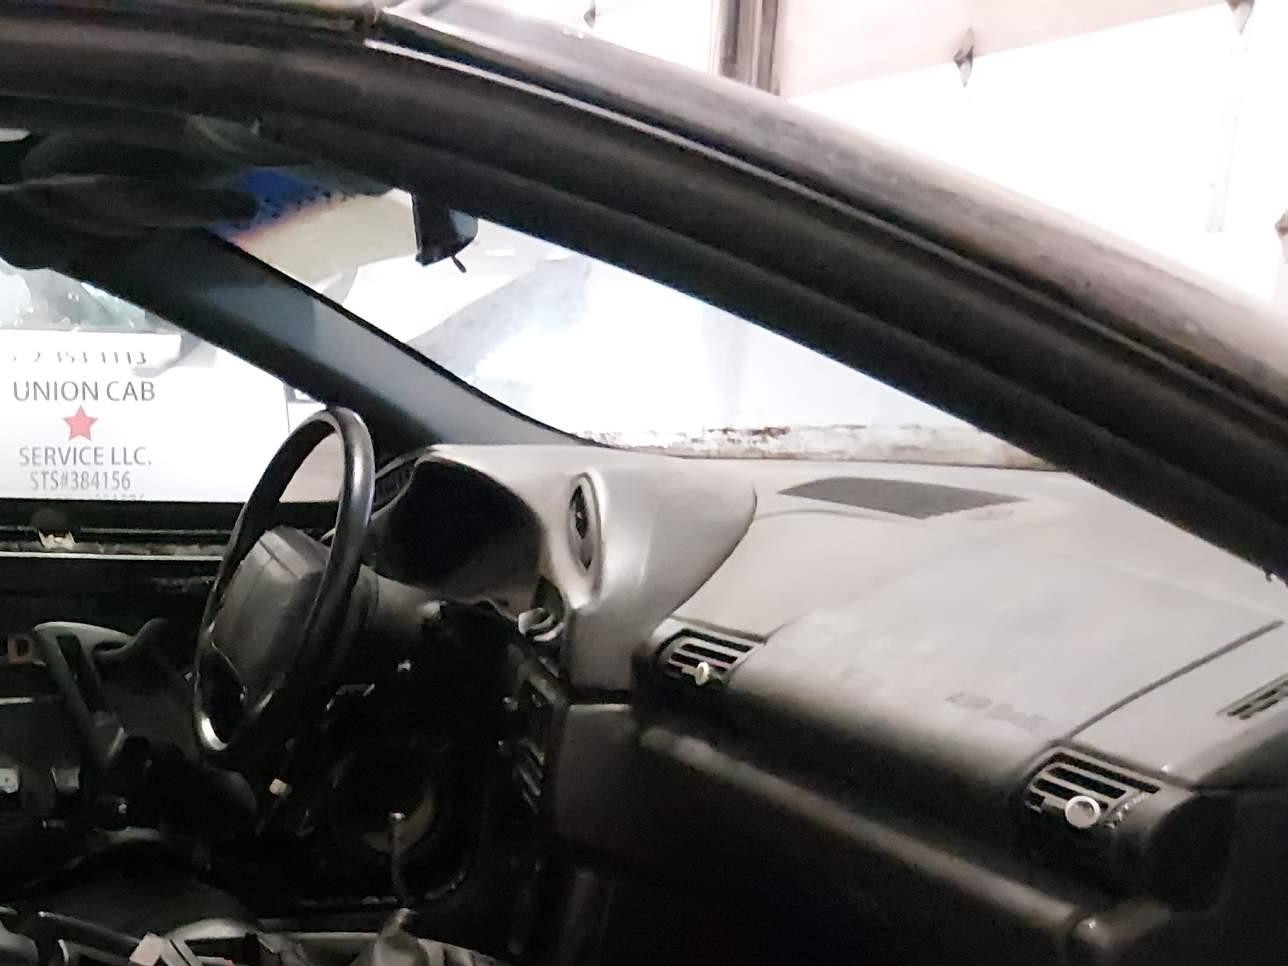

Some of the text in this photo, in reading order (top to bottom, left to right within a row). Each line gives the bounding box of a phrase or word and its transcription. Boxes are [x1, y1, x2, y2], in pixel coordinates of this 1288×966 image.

[12, 380, 156, 402] UNION CAB
[18, 445, 153, 467] SERVICE LLC.
